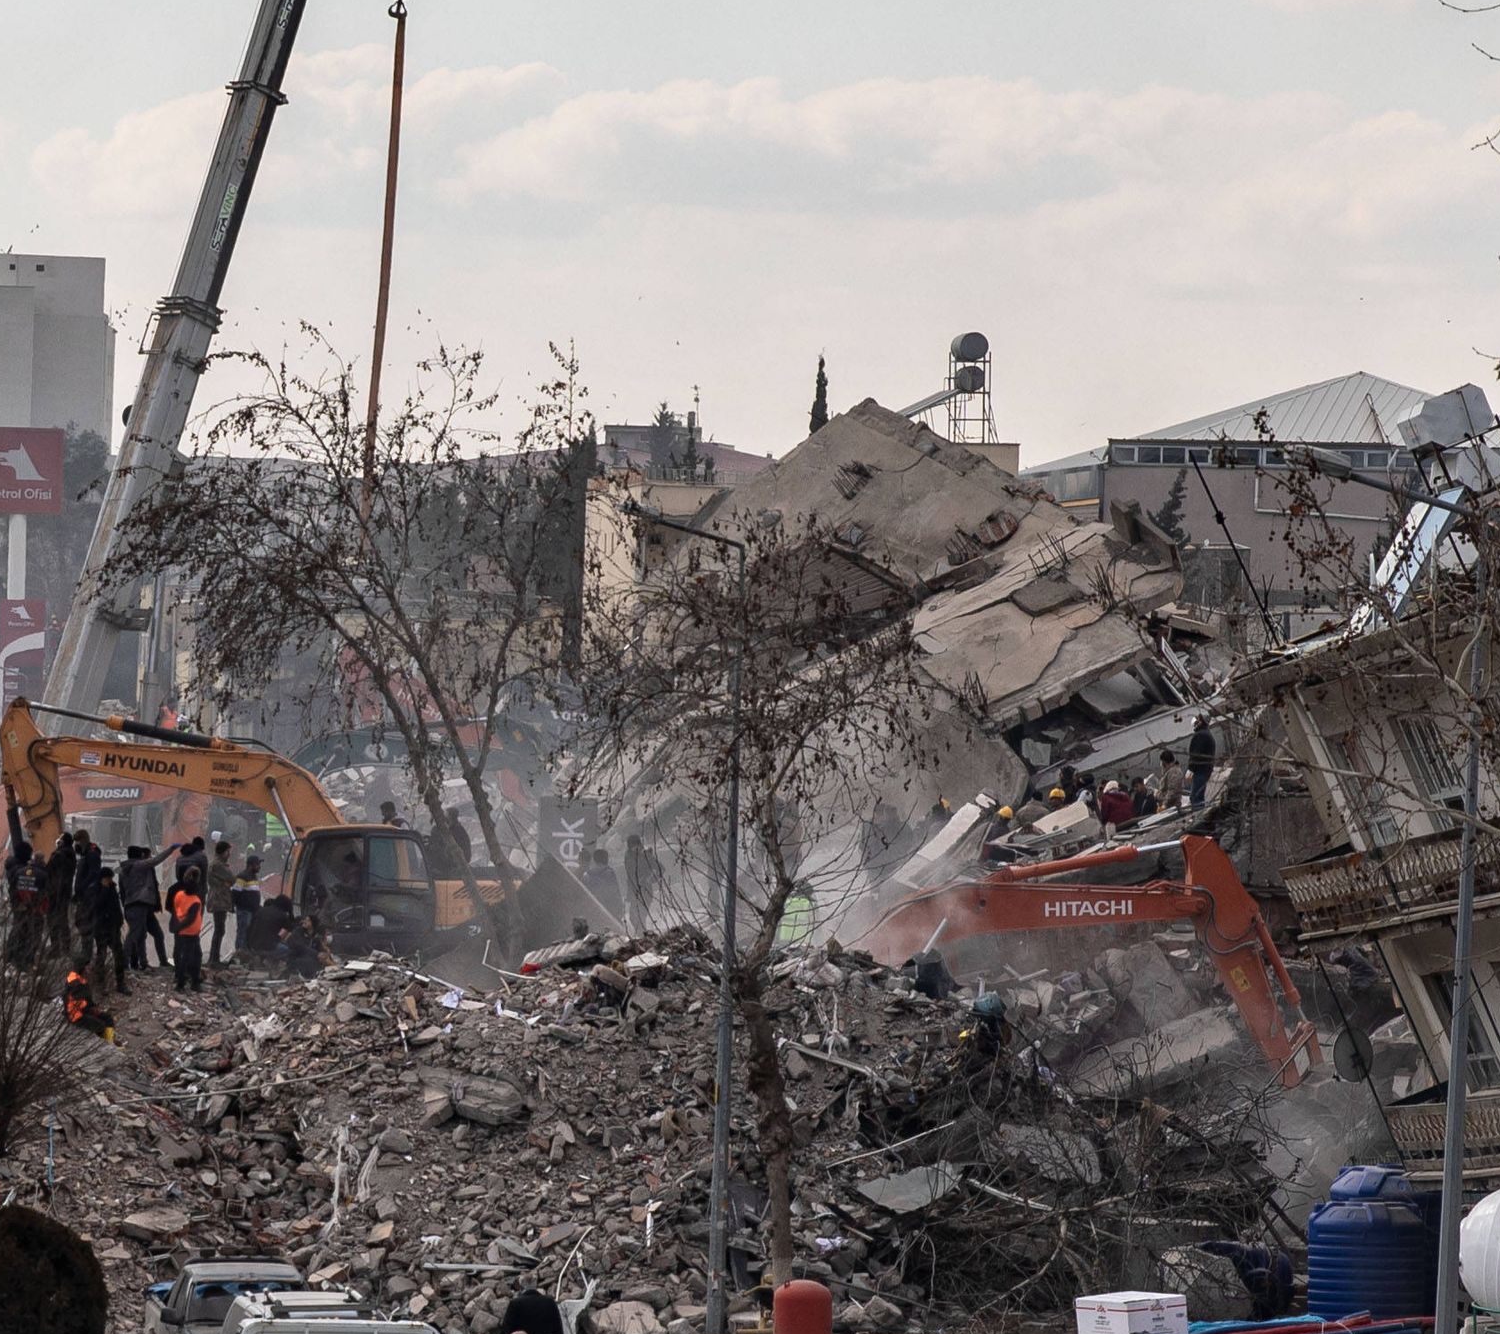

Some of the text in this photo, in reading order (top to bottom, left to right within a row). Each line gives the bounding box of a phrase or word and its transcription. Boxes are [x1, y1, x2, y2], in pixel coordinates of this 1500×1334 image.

[24, 488, 51, 500] Ofisi
[104, 753, 186, 777] HYUNDAI
[85, 788, 139, 799] DOOSAN
[1044, 900, 1133, 917] HITACHI
